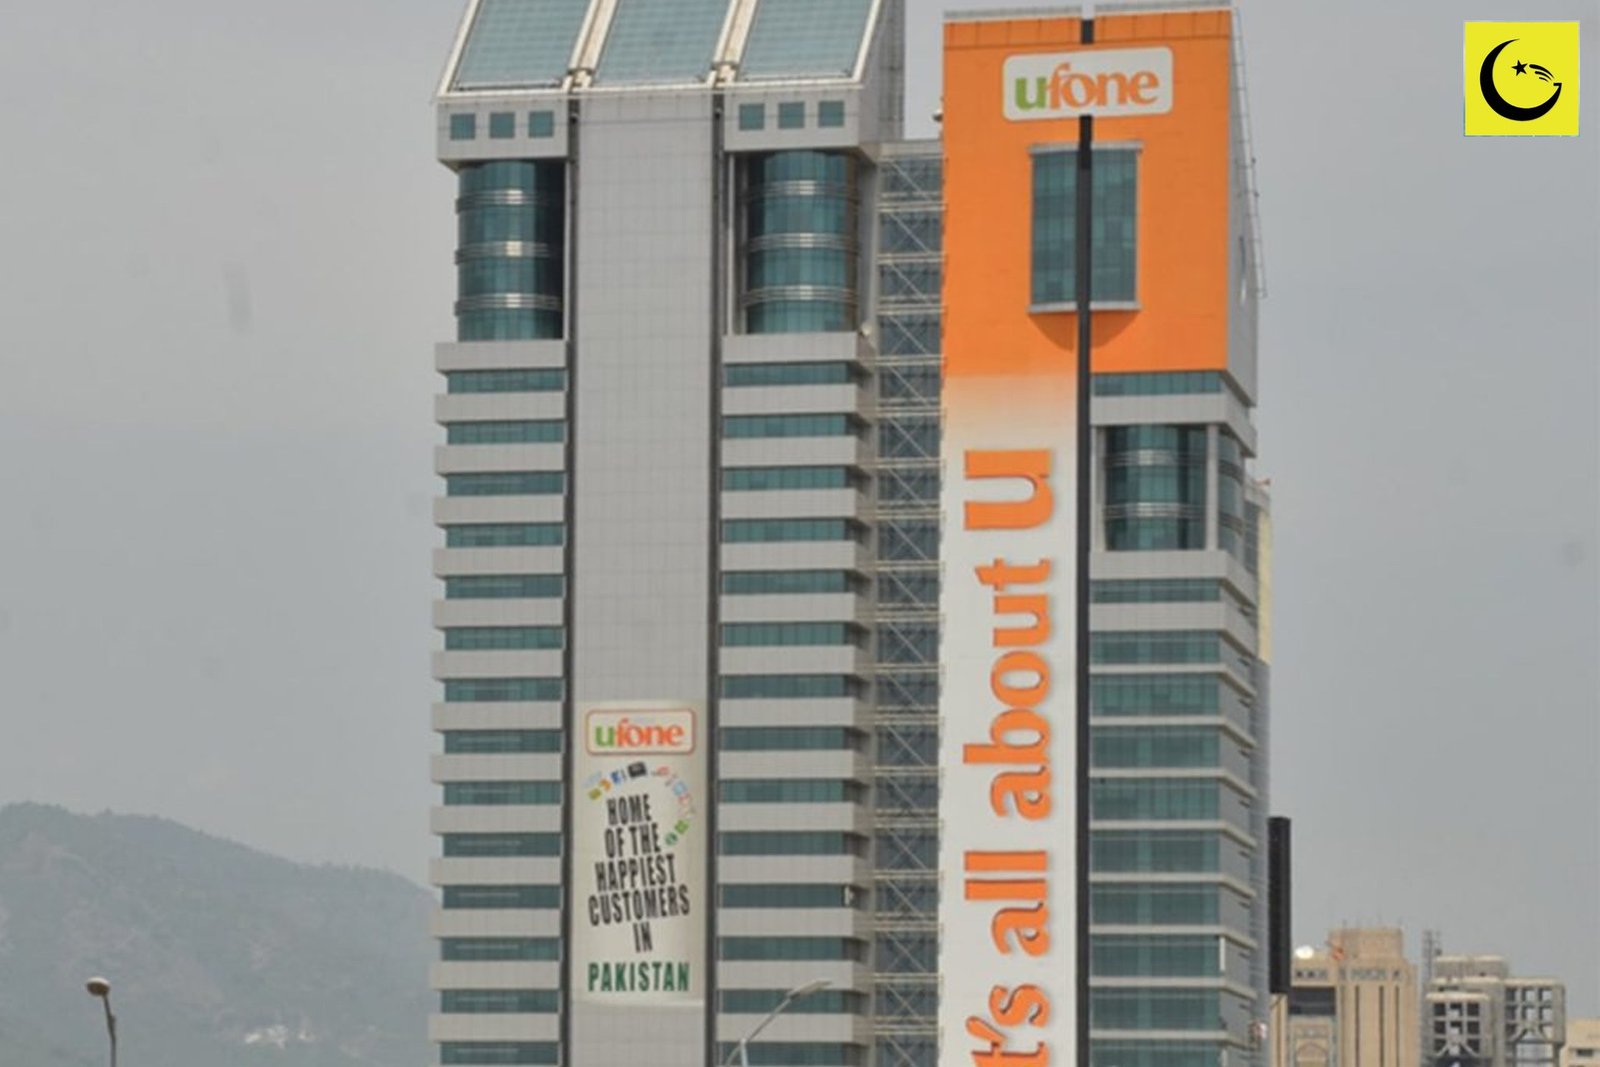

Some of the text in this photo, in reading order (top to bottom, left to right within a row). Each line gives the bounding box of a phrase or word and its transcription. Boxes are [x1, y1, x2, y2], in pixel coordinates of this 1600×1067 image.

[1015, 62, 1160, 110] ufone
[963, 559, 1052, 821] about
[595, 719, 684, 747] ufone
[607, 794, 652, 825] HOME
[604, 823, 661, 858] OF THE
[595, 854, 676, 892] HAPPIEST
[588, 885, 690, 926] CUSTOMERS
[964, 850, 1050, 957] all
[633, 922, 652, 952] IN
[588, 962, 690, 992] PAKISTAN
